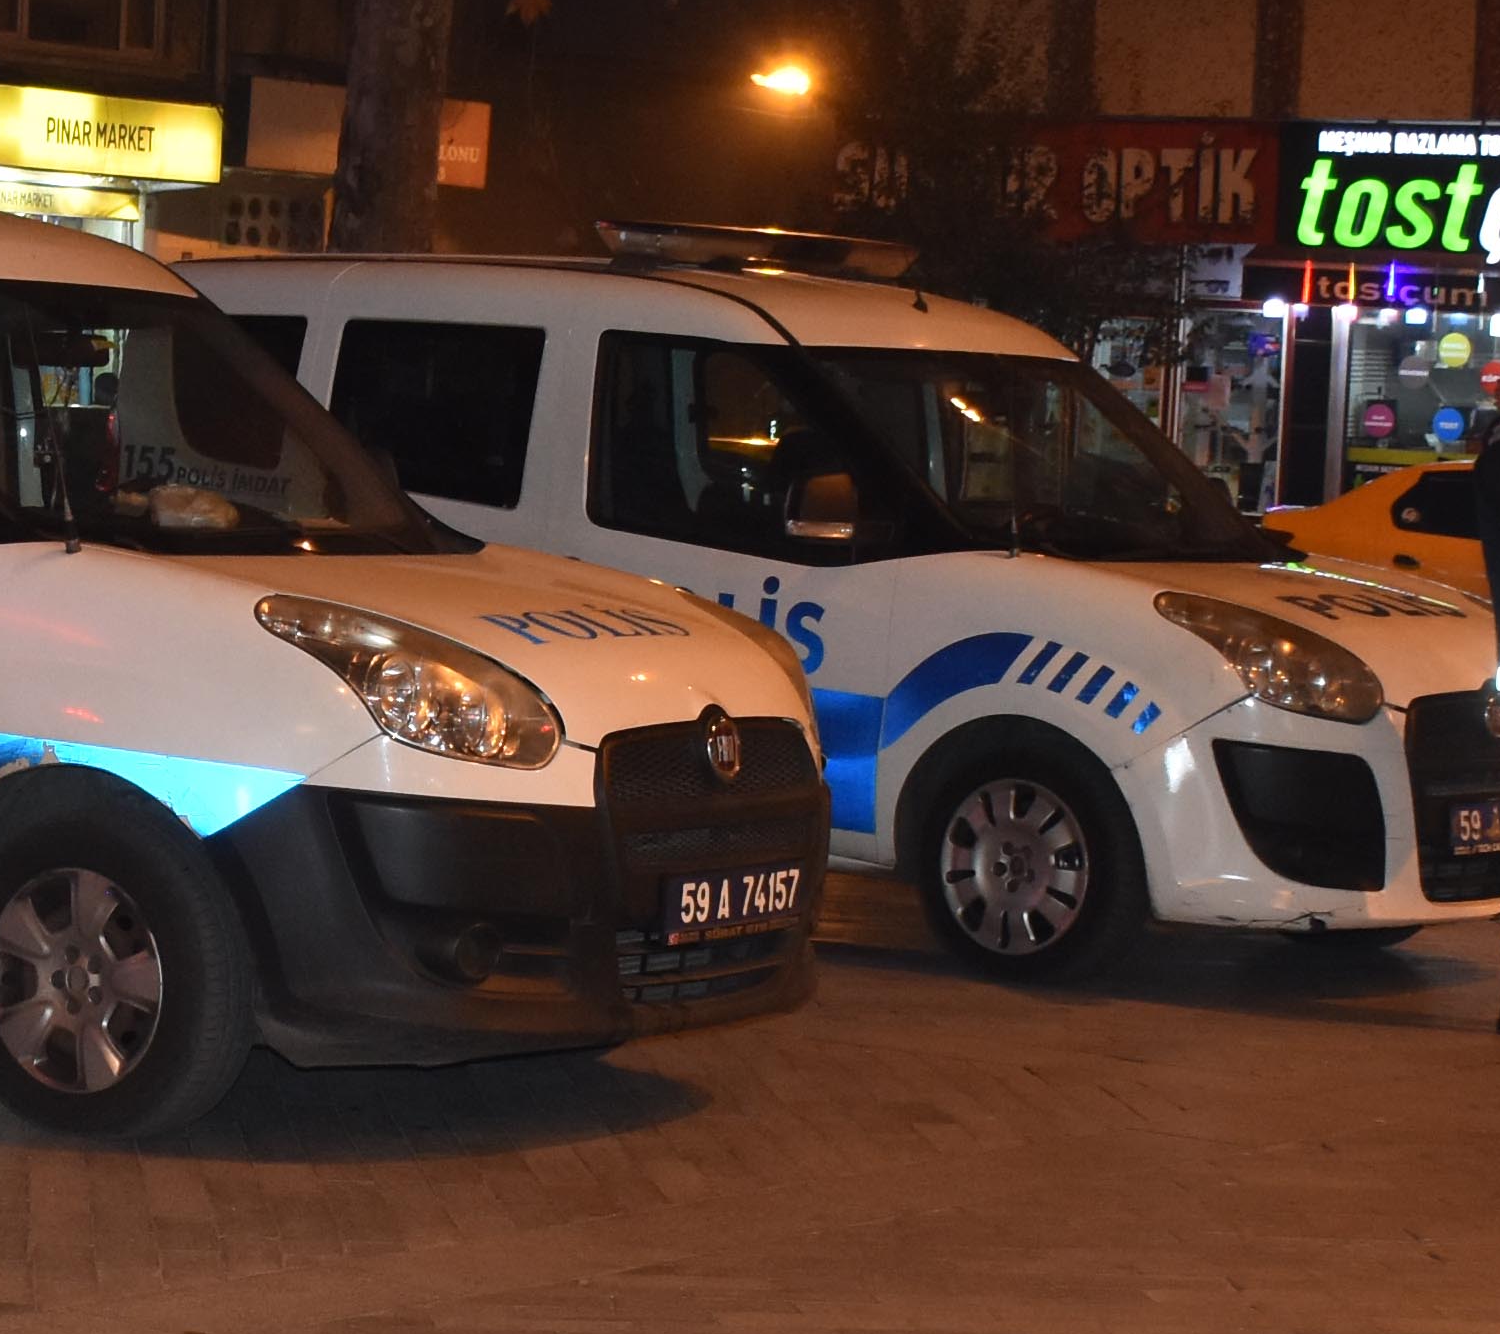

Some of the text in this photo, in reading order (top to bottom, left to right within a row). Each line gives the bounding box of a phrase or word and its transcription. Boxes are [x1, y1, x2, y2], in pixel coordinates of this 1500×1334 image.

[45, 116, 156, 154] PINAR MARKET
[1081, 130, 1259, 224] OPTİK
[478, 602, 695, 646] POLİS
[1275, 591, 1468, 621] POLİS
[1459, 809, 1482, 842] 59
[680, 868, 800, 924] 59 A 74157
